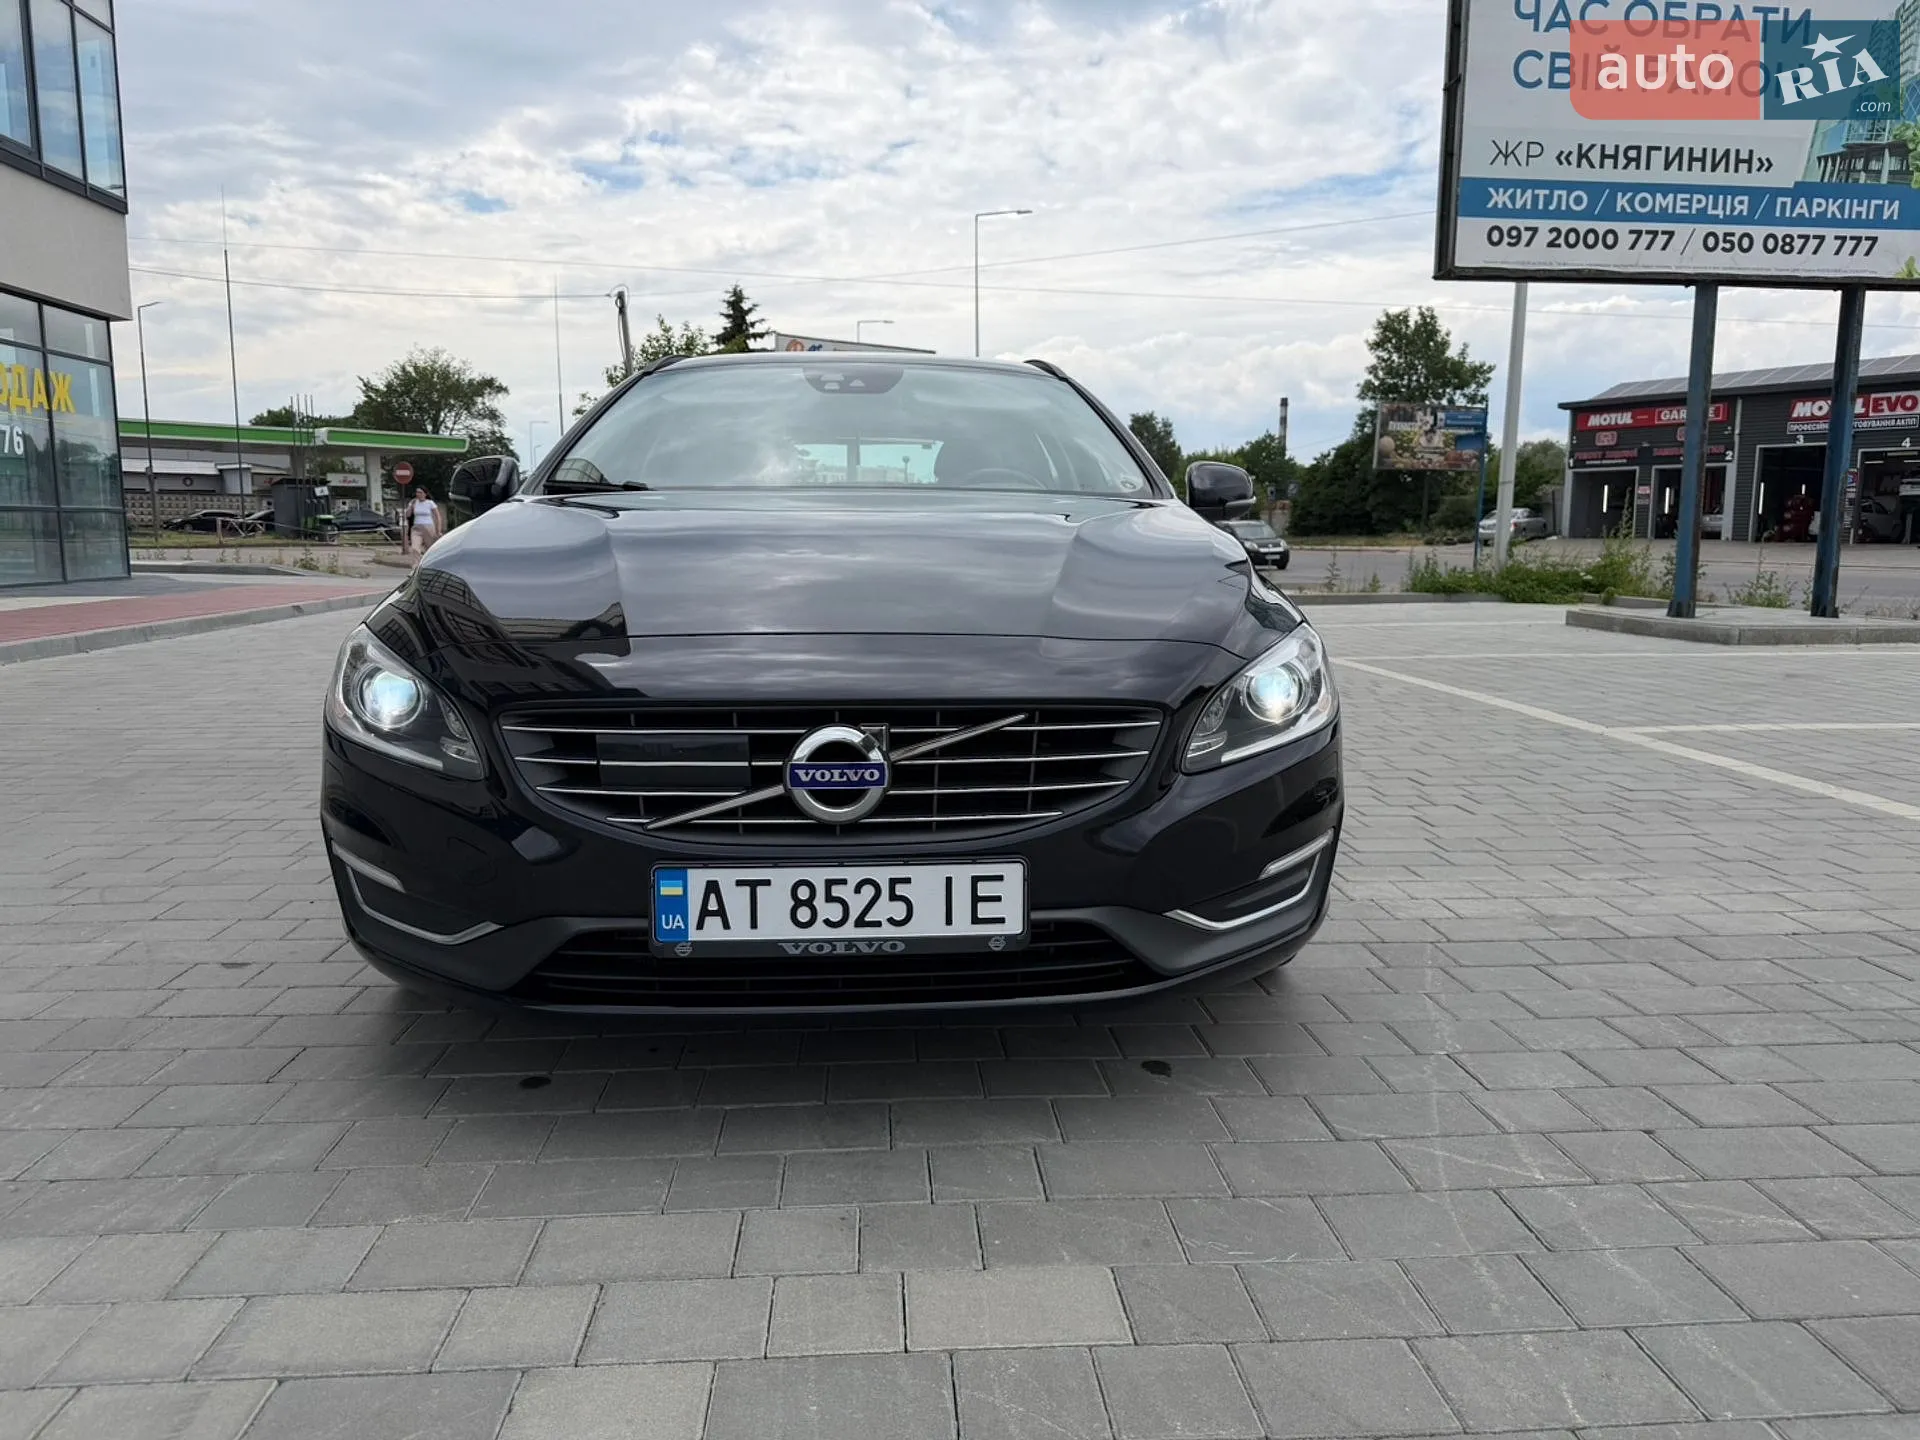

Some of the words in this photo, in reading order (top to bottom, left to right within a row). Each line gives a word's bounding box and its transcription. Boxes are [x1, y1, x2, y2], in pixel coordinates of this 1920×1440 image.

[1513, 0, 1609, 36] ЧАС
[1623, 0, 1813, 43] ОБРАТИ
[1489, 139, 1544, 168] ЖР
[1555, 142, 1774, 174] «КНЯГИНИН»
[1486, 187, 1588, 213] ЖИТЛО
[1615, 191, 1749, 219] КОМЕРЦІЯ
[1775, 195, 1900, 220] ПАРКІНГИ
[1486, 225, 1539, 248] 097
[1546, 226, 1619, 251] 2000
[1628, 229, 1676, 252] 777
[1702, 231, 1754, 255] 050
[1762, 232, 1826, 256] 0877
[1833, 234, 1878, 257] 777
[1588, 411, 1634, 427] MOTUL
[1660, 406, 1714, 420] GARE
[1791, 397, 1866, 418] MOL
[1872, 395, 1918, 413] EVO
[1795, 435, 1805, 445] 3
[1901, 437, 1911, 448] 4
[1725, 450, 1734, 461] 2
[793, 766, 881, 783] VOLVO
[695, 879, 772, 932] AT
[788, 876, 915, 929] 8525
[944, 874, 1007, 925] IE
[661, 913, 686, 931] UA
[778, 939, 907, 955] VOLVO
